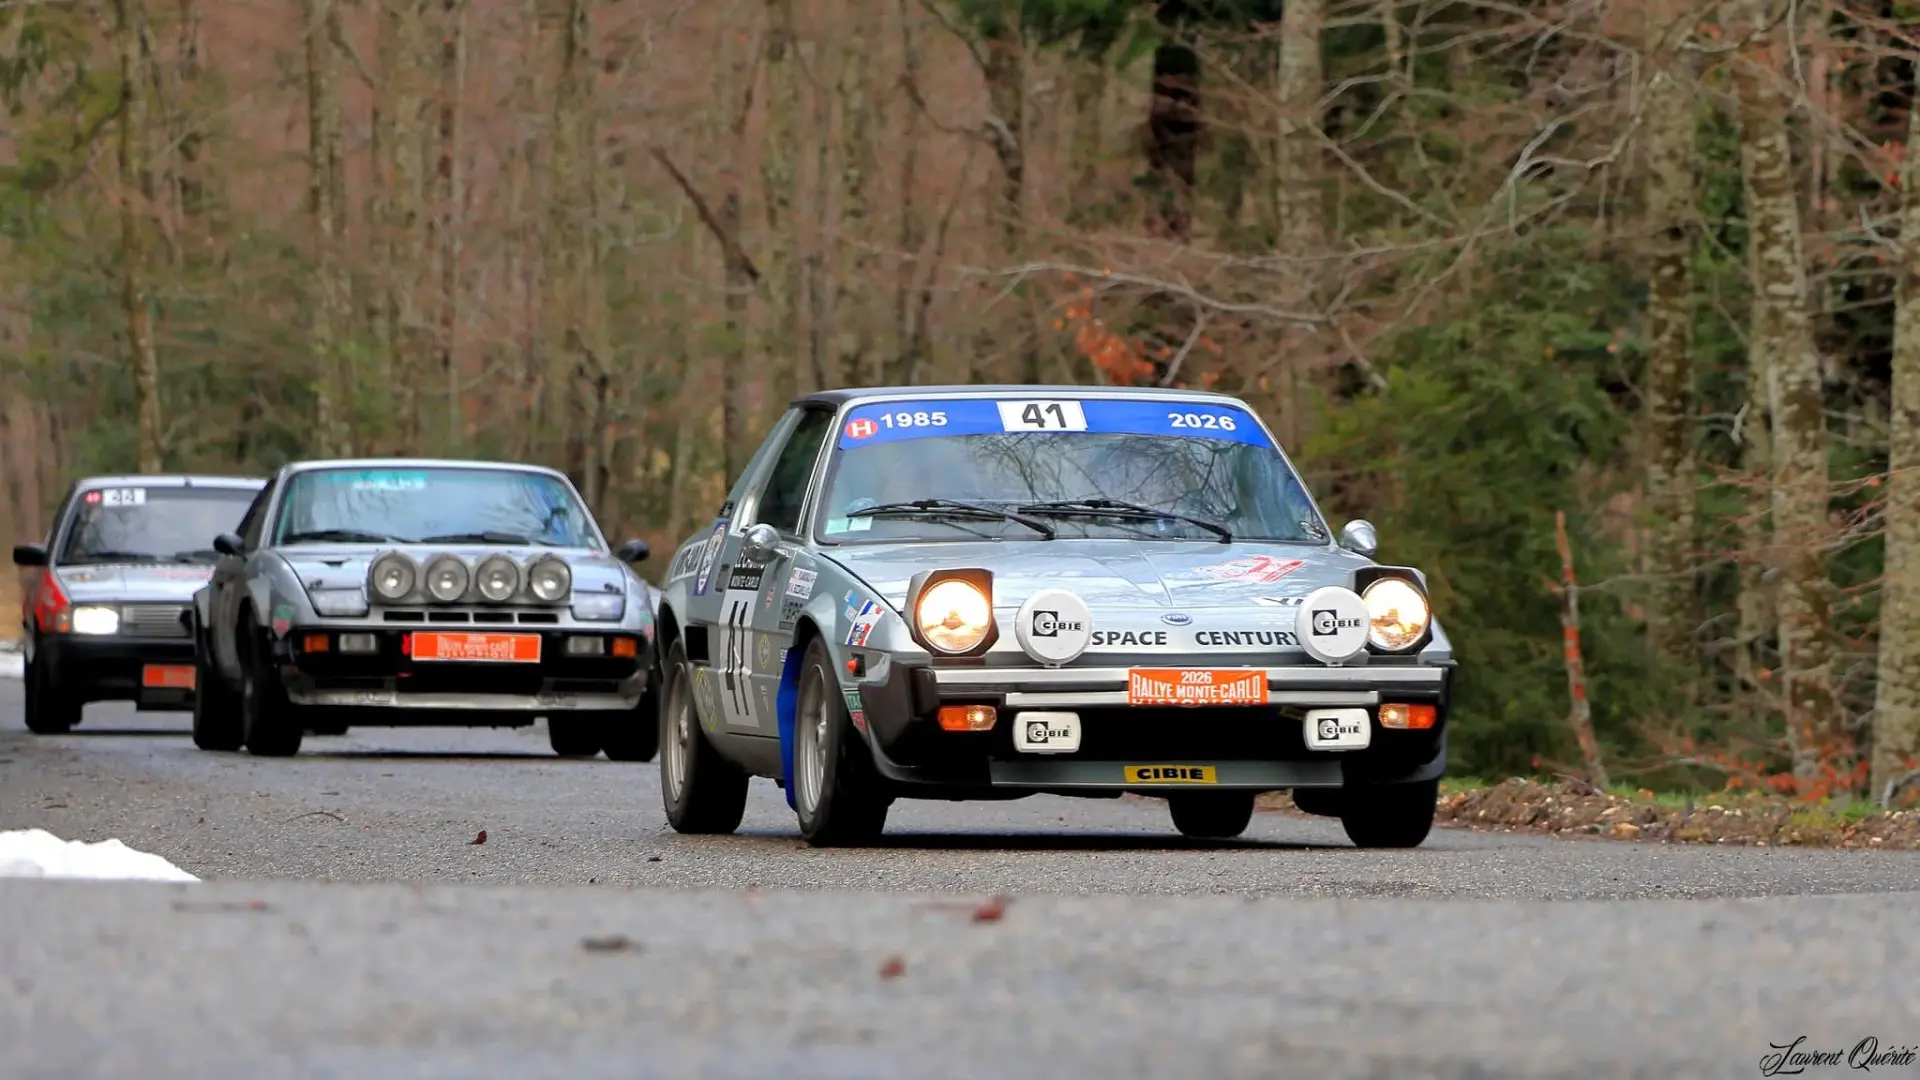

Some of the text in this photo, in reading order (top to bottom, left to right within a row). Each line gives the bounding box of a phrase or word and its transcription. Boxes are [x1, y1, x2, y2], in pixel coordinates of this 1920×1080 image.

[851, 403, 1236, 437] H 1985 41 2026
[1091, 631, 1300, 645] SPACE CENTURY
[1131, 672, 1261, 699] RALLYE MONTE-CARLO
[1180, 671, 1213, 684] 2026
